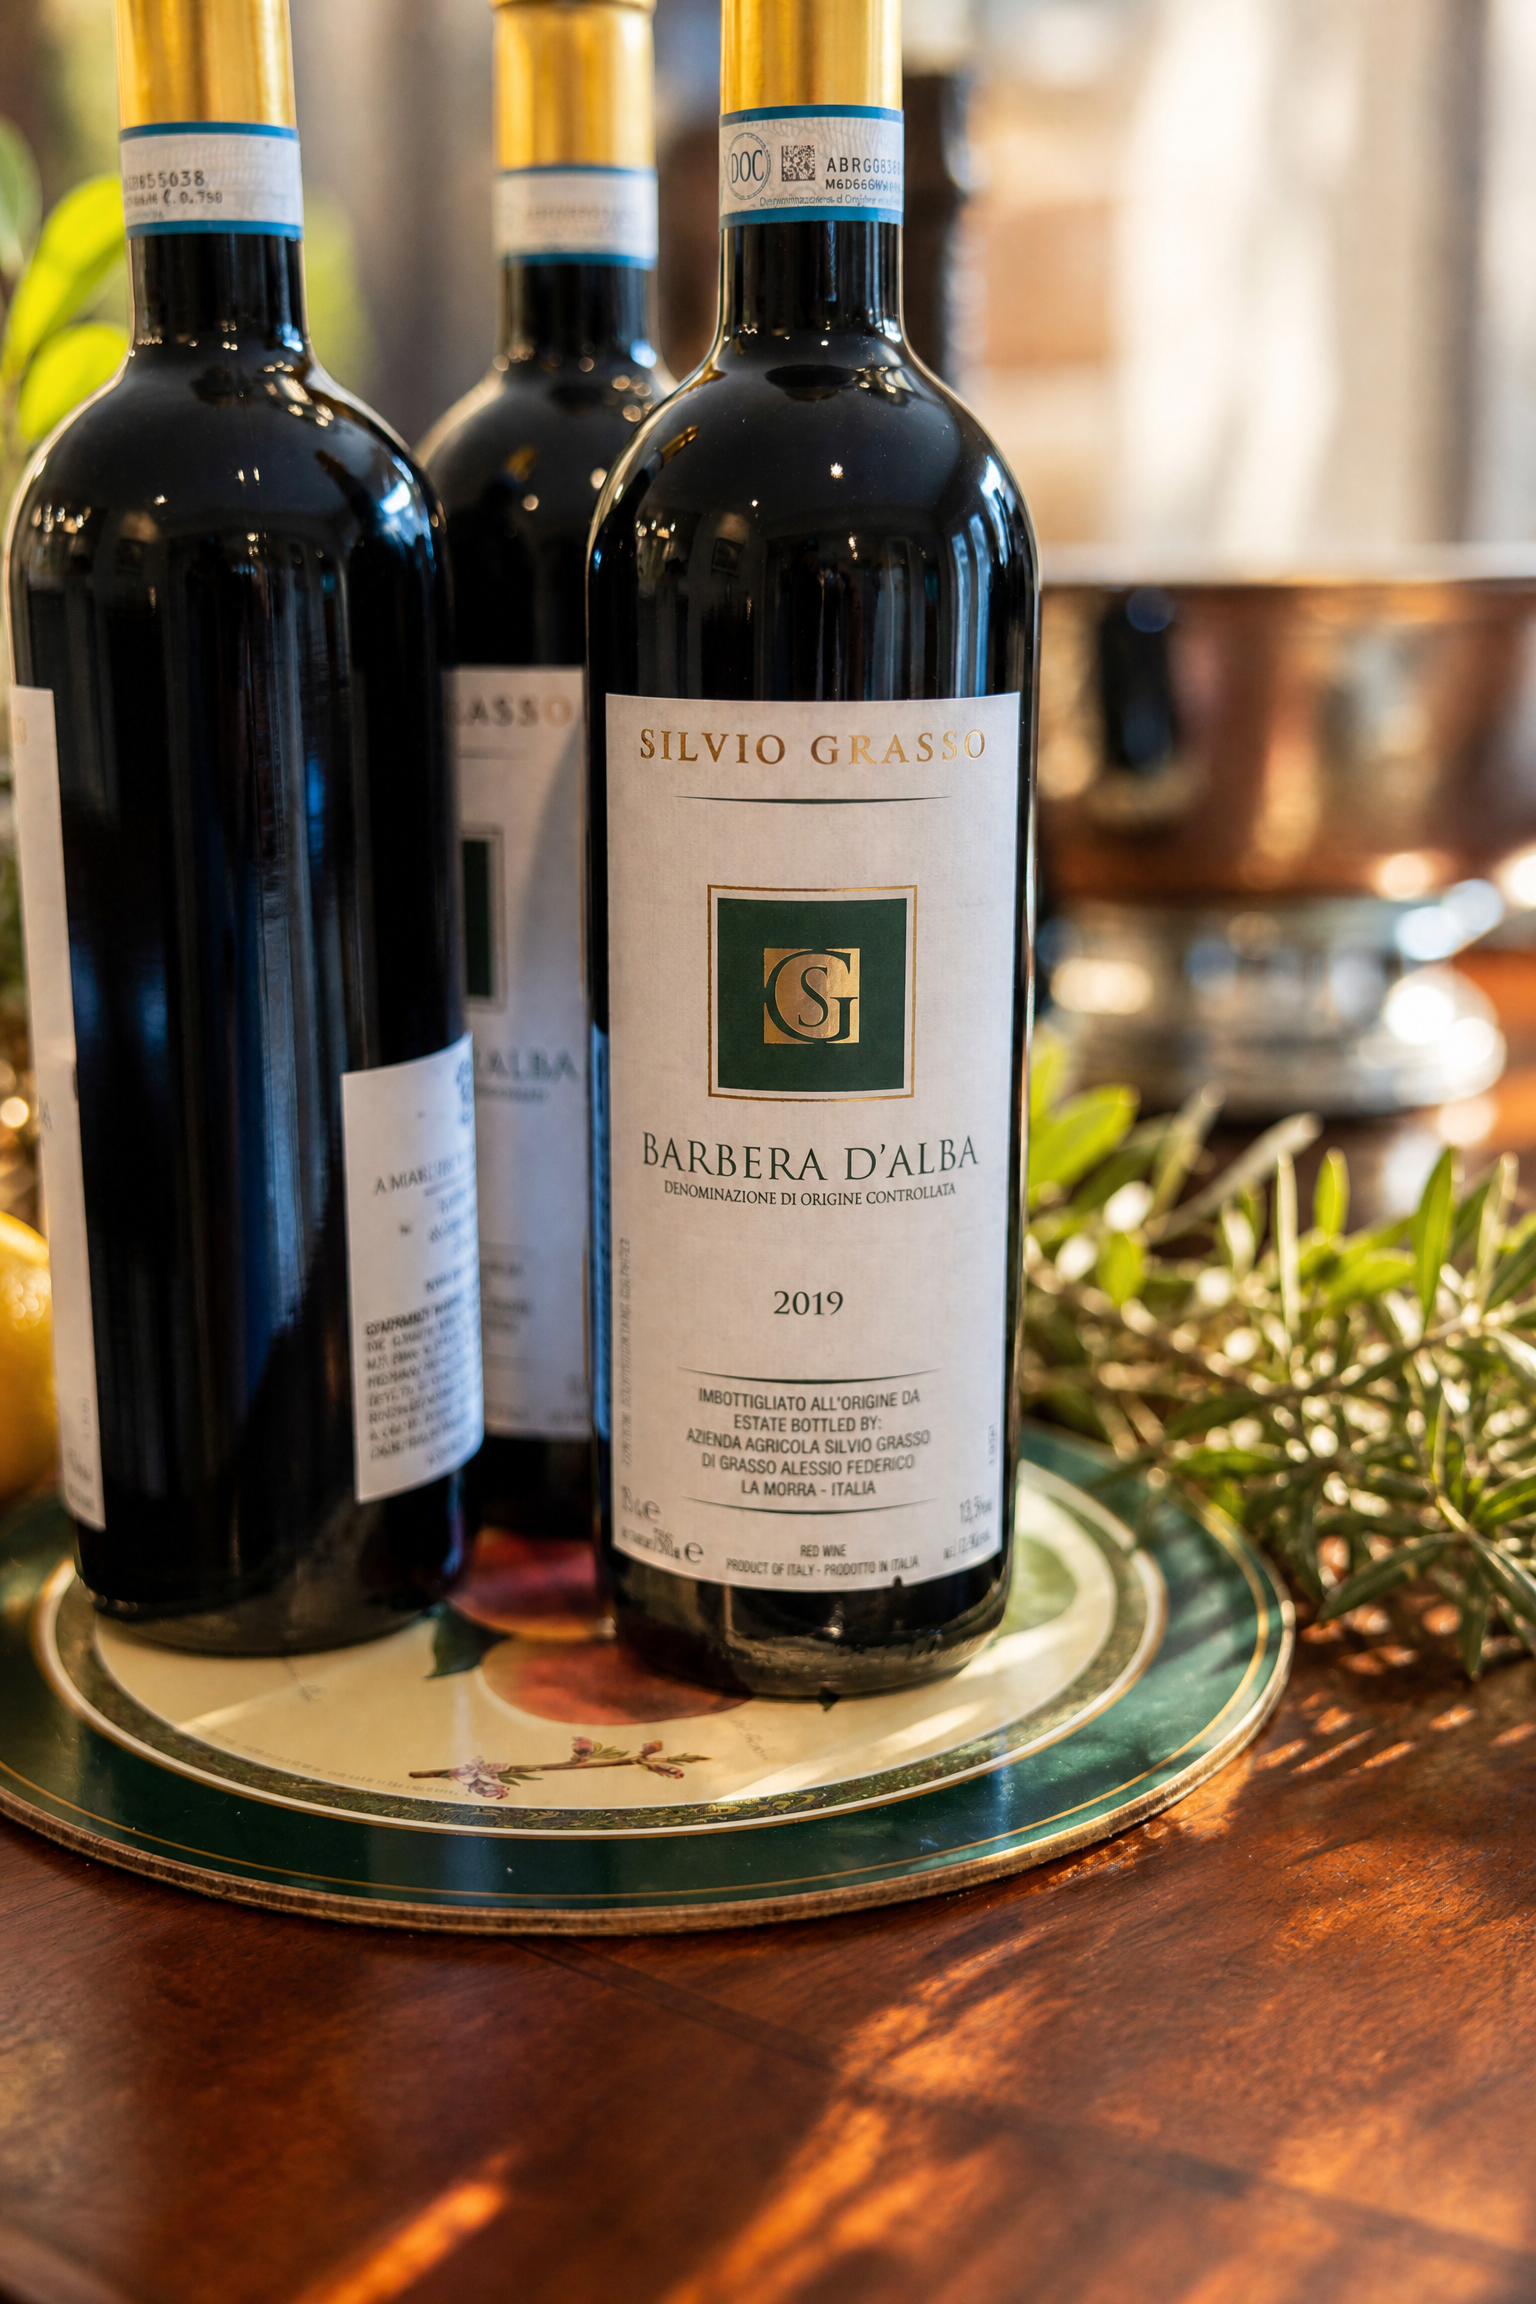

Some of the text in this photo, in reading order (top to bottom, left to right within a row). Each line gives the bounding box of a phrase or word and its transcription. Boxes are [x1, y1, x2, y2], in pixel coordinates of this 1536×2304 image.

[731, 150, 764, 184] DOC
[458, 693, 573, 729] ASSO
[640, 727, 986, 765] SILVIO GRASSO
[642, 1131, 979, 1181] BARBERA D’ALBA
[664, 1179, 956, 1206] DENOMINAZIONE DI ORIGINE CONTROLLATA
[773, 1290, 844, 1316] 2019
[698, 1387, 920, 1411] IMBOTTIGLIATO ALL'ORIGINE DA
[734, 1413, 882, 1432] ESTATE BOTTLED BY:
[686, 1427, 931, 1454] AZIENDA AGRICOLA SILVIO GRASSO
[702, 1452, 915, 1475] DI GRASSO ALESSIO FEDERICO
[741, 1480, 759, 1494] LA
[764, 1481, 817, 1497] MORRA
[832, 1480, 876, 1496] ITALIA
[800, 1543, 848, 1557] RED WINE
[726, 1558, 769, 1574] PRODUCT
[772, 1562, 784, 1575] OF
[787, 1563, 815, 1576] ITALY
[824, 1561, 876, 1576] PRODOTTO
[879, 1559, 888, 1572] IN
[891, 1554, 920, 1571] ITALIA
